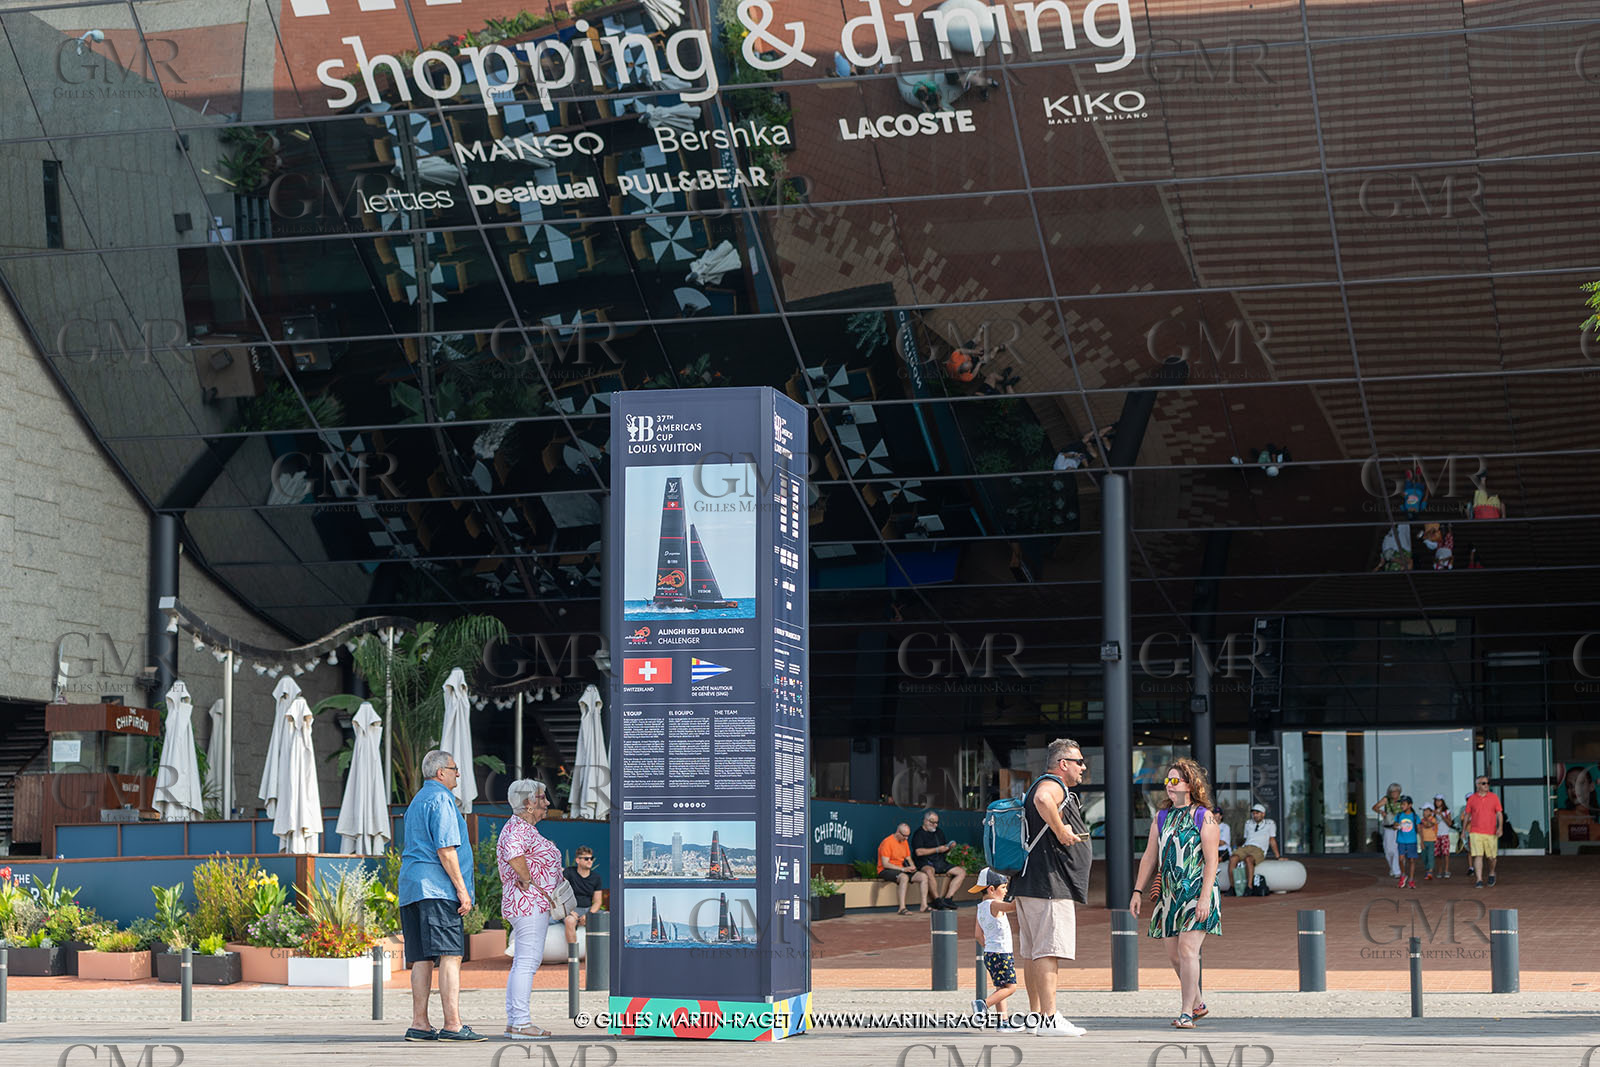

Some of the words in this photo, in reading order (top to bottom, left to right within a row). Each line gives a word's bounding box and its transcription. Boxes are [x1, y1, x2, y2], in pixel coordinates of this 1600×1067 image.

[316, 19, 719, 116] shopping
[735, 0, 817, 71] &
[839, 0, 1138, 73] dining
[1043, 90, 1146, 118] KIKO
[1106, 112, 1148, 121] MILANO
[654, 121, 792, 153] Bershka
[838, 109, 976, 141] LACOSTE
[454, 131, 605, 164] MANGO
[468, 176, 600, 206] Desigual
[616, 166, 769, 196] PULL&BEAR
[357, 187, 455, 214] lefties
[656, 423, 702, 432] AMERICA'S
[656, 433, 674, 442] CUP
[628, 444, 657, 454] LOUIS
[659, 442, 702, 453] VUITTON
[115, 715, 149, 733] CHIPIRÓN
[814, 820, 853, 845] CHIPIRÓN
[13, 873, 31, 884] THE
